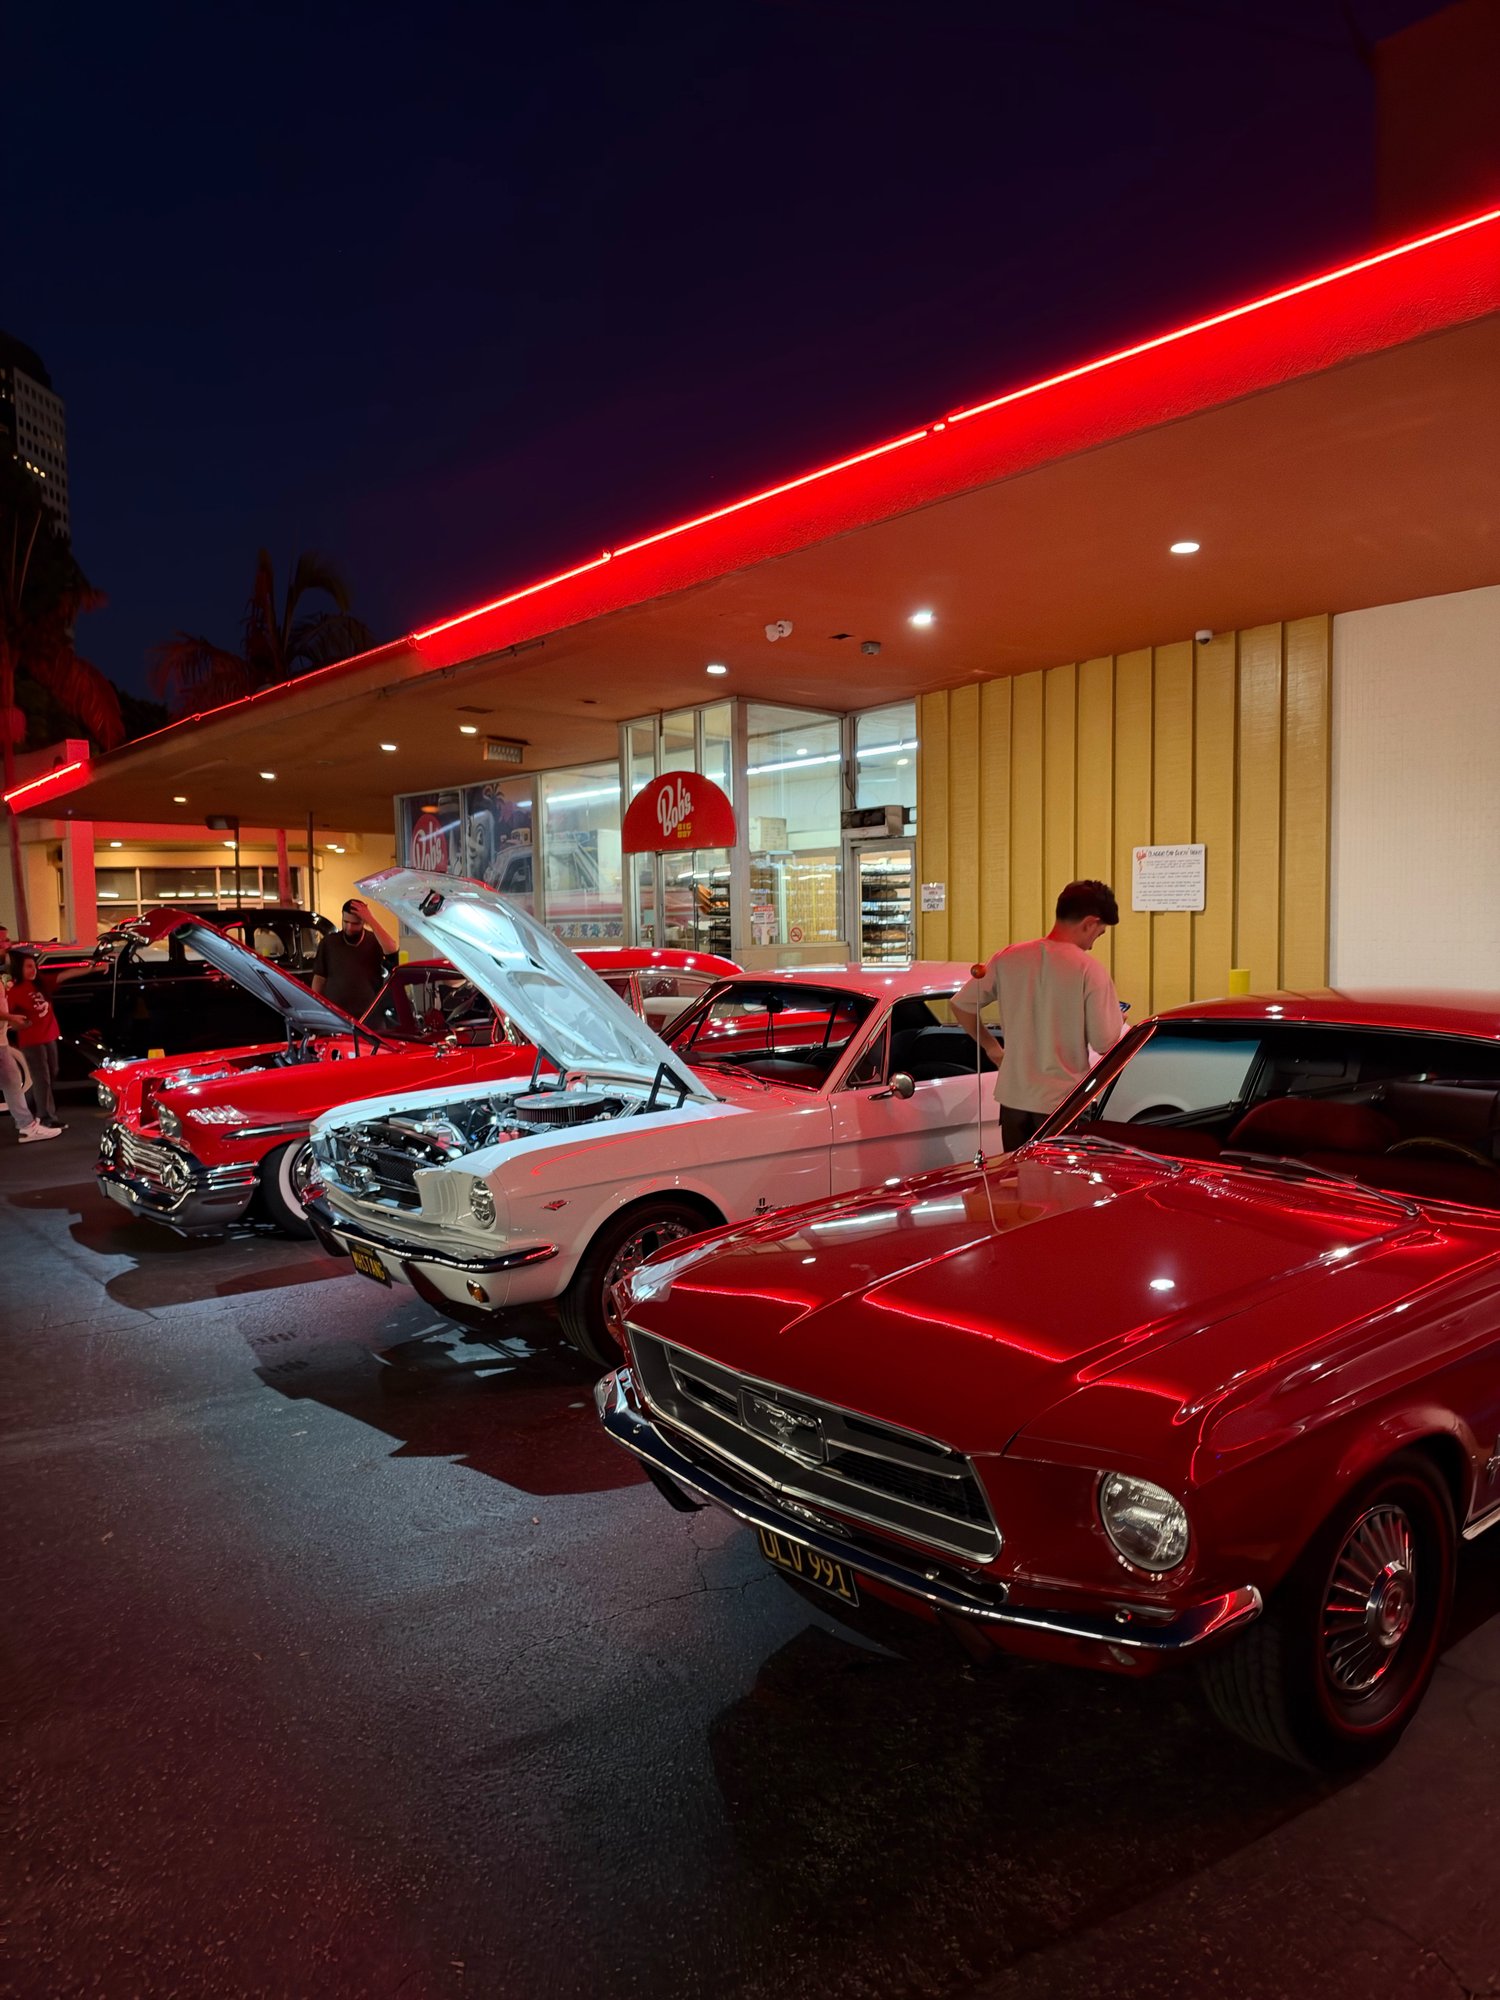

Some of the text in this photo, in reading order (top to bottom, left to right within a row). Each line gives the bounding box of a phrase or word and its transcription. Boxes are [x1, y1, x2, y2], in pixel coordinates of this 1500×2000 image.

[657, 777, 692, 837] Bob's
[677, 822, 692, 831] BIG
[677, 830, 692, 839] BOY
[759, 1528, 852, 1598] ULV 991
